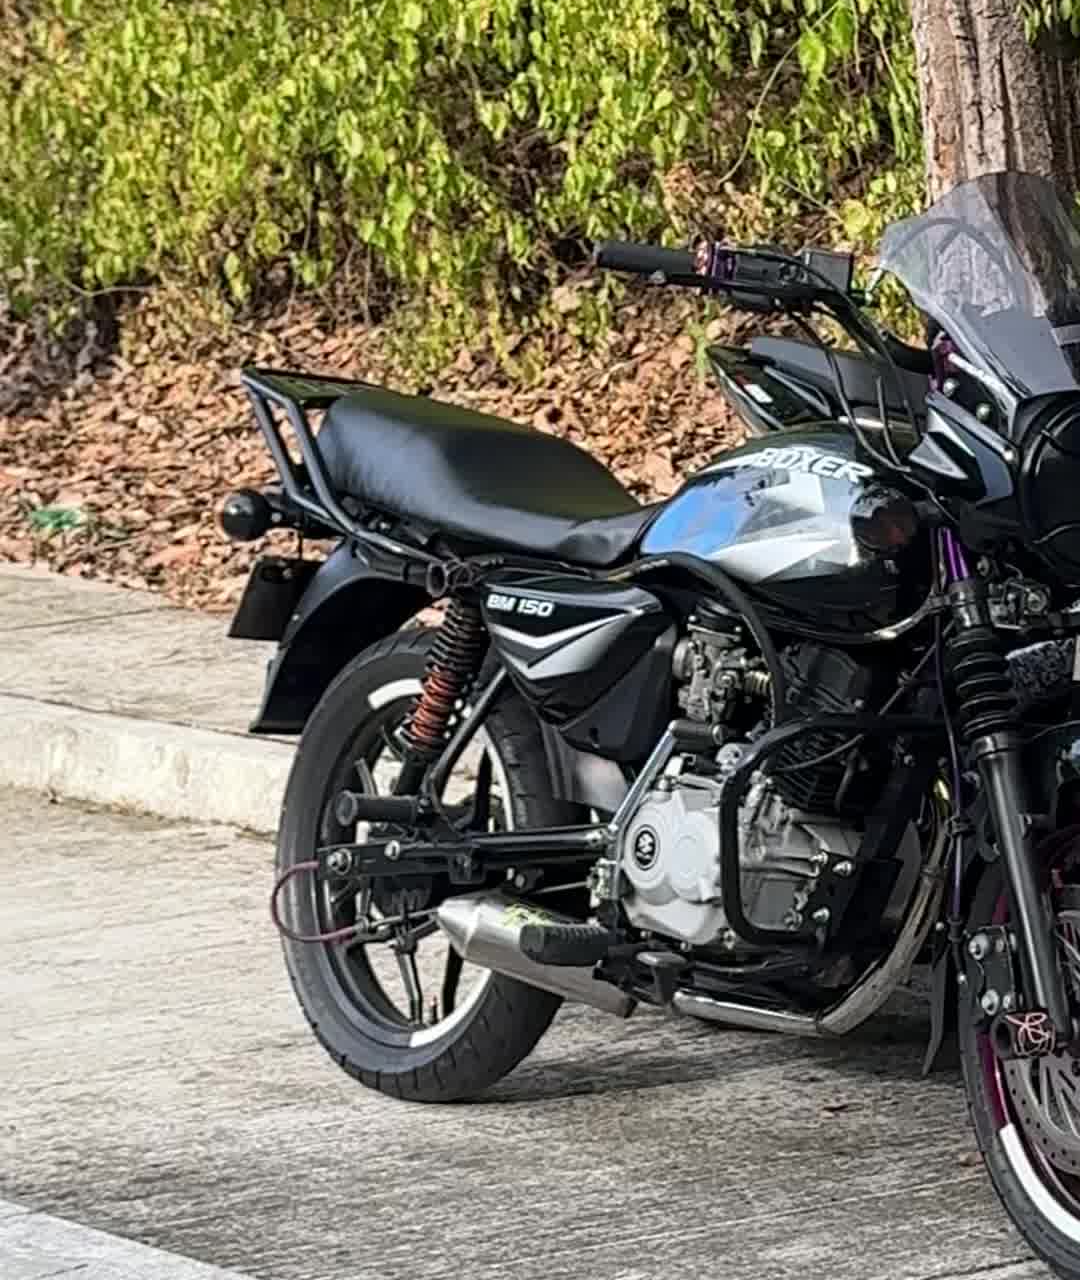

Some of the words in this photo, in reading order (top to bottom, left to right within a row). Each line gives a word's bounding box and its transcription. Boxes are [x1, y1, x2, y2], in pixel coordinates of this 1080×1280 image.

[753, 444, 875, 484] BOXER
[486, 593, 516, 612] BM
[517, 598, 555, 617] 150
